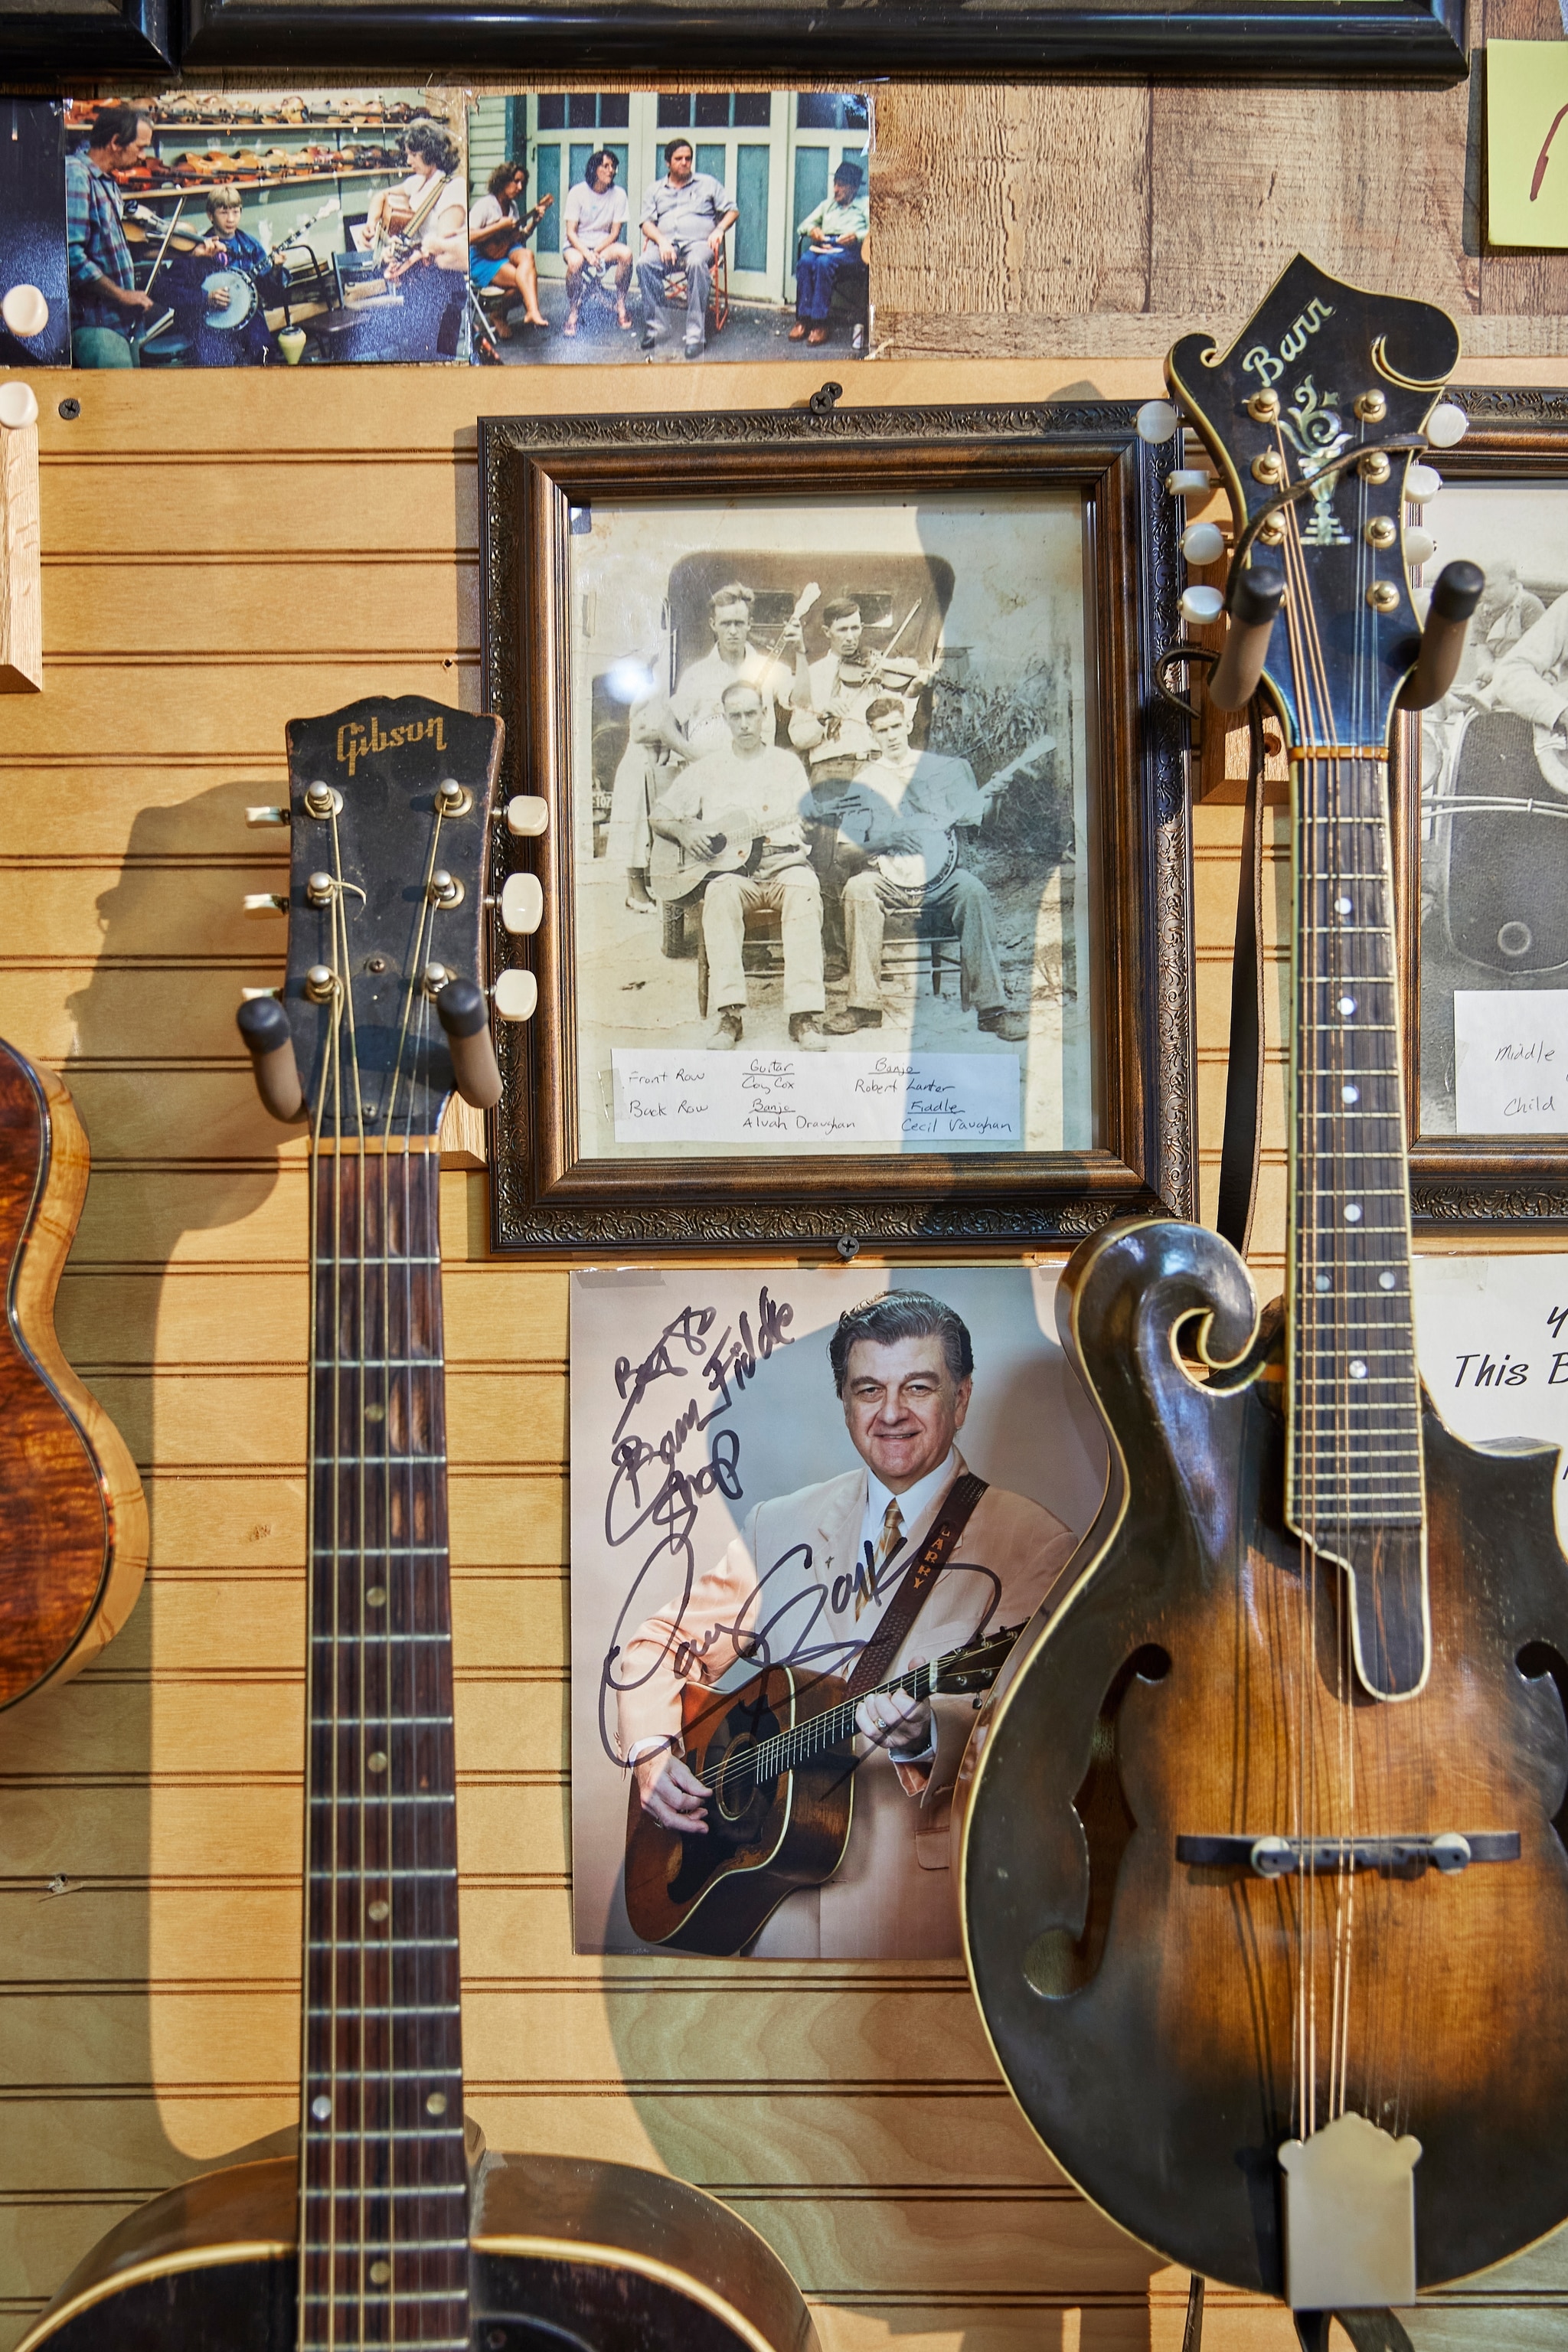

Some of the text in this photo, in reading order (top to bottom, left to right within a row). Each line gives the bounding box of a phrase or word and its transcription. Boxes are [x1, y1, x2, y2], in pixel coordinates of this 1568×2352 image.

[1241, 296, 1333, 387] Barr
[336, 716, 447, 777] Gibson
[1494, 1040, 1556, 1063] Middle
[750, 1058, 794, 1073] Guitar
[874, 1057, 914, 1076] Banjo
[629, 1068, 705, 1084] Front Row
[773, 1076, 795, 1089] Cox
[854, 1078, 898, 1094] Robert
[629, 1099, 709, 1118] Back Row
[752, 1098, 791, 1115] Banjo
[910, 1098, 965, 1114] Fiddle
[1503, 1095, 1556, 1116] Child
[742, 1116, 788, 1131] Alvah
[900, 1116, 1012, 1135] Cecil Vaughan
[1454, 1354, 1530, 1388] This
